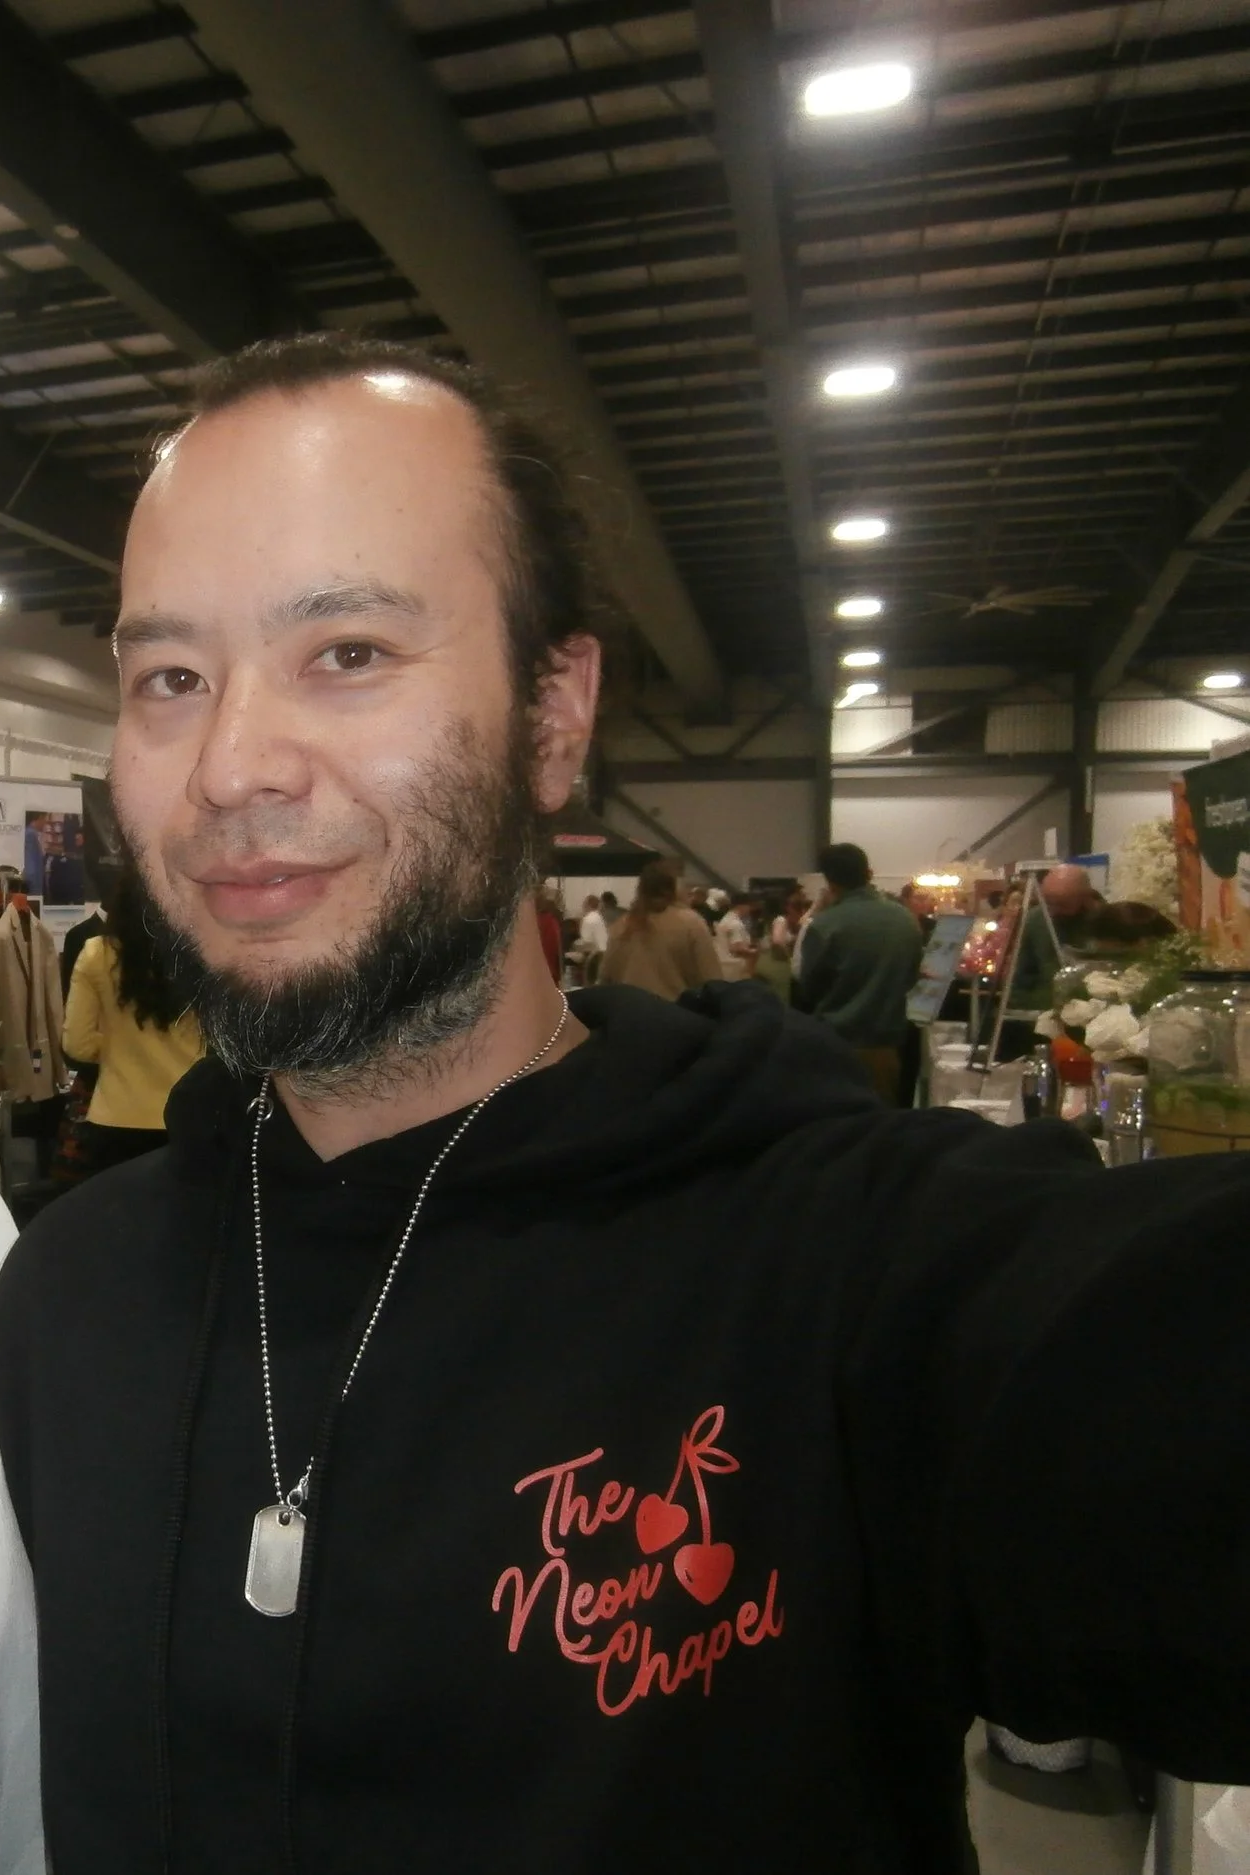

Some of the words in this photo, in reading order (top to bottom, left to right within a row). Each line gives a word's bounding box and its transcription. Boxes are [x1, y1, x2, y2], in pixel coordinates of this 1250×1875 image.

[514, 1447, 635, 1558] The
[491, 1556, 664, 1656] Neon
[595, 1569, 786, 1717] Chapel
